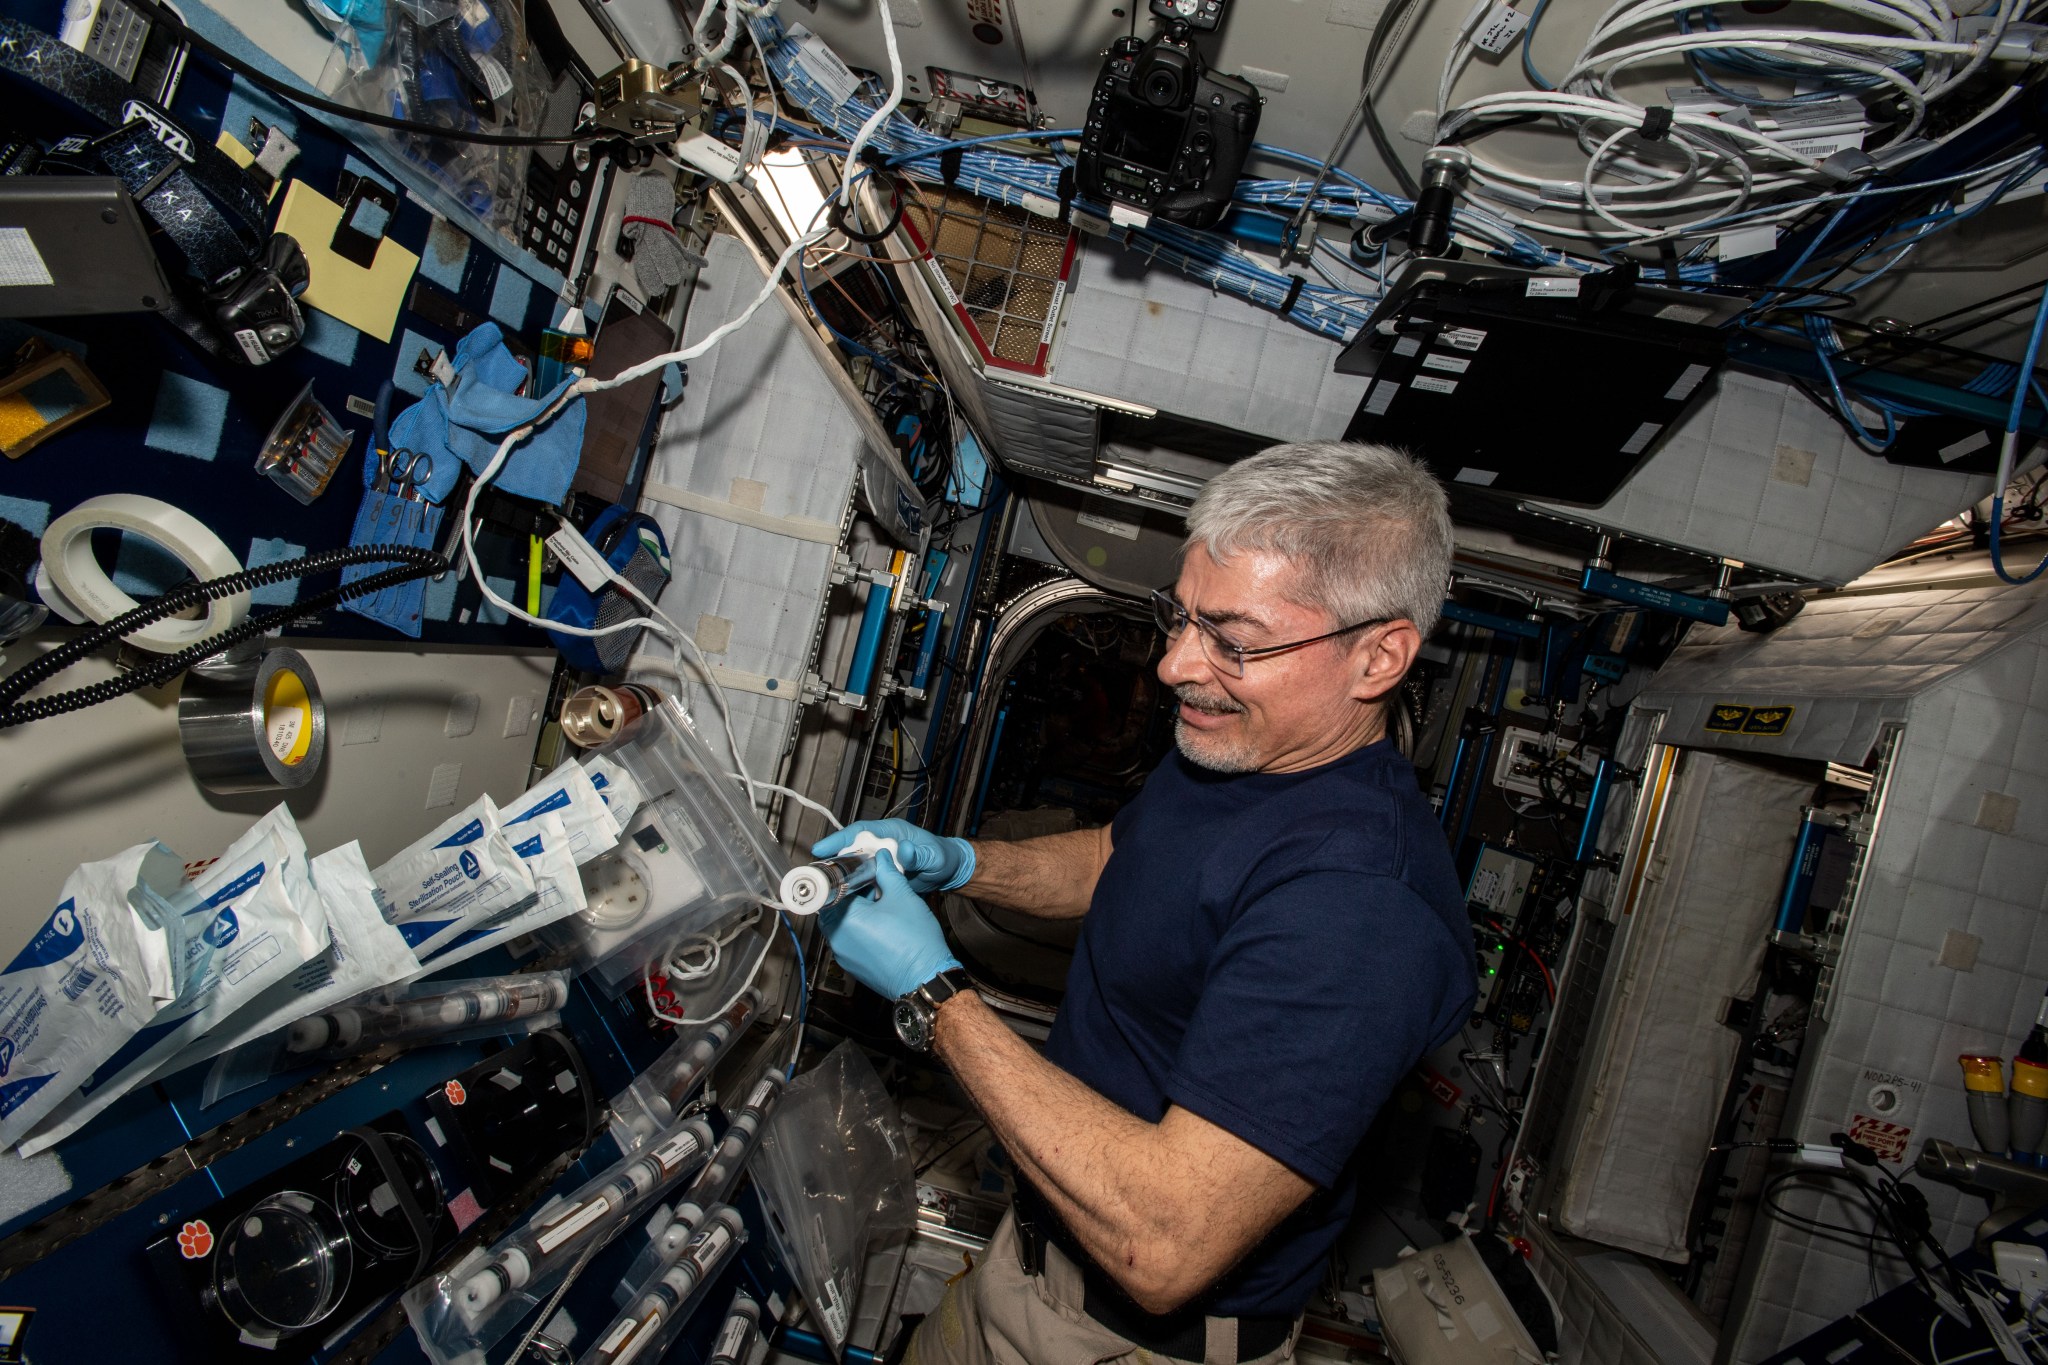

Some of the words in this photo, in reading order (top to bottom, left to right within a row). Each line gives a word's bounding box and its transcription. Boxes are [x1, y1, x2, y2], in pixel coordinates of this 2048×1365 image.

[123, 102, 195, 163] PETZL
[946, 290, 957, 304] FWD
[1052, 282, 1063, 305] Exhaust
[1048, 305, 1057, 322] Outlet
[1042, 322, 1052, 342] Screen
[370, 501, 382, 522] 8
[388, 504, 402, 526] 9
[289, 720, 296, 730] 3M
[273, 724, 286, 748] 1810340
[422, 863, 460, 890] Self-Sealing
[407, 882, 444, 909] Sterilization
[442, 870, 464, 887] Pouch
[57, 918, 68, 932] 1
[21, 994, 50, 1027] Sterilization
[9, 1023, 29, 1043] Pouch
[1863, 1133, 1877, 1142] FIRE
[1878, 1136, 1895, 1146] PORT
[349, 1160, 360, 1172] 15
